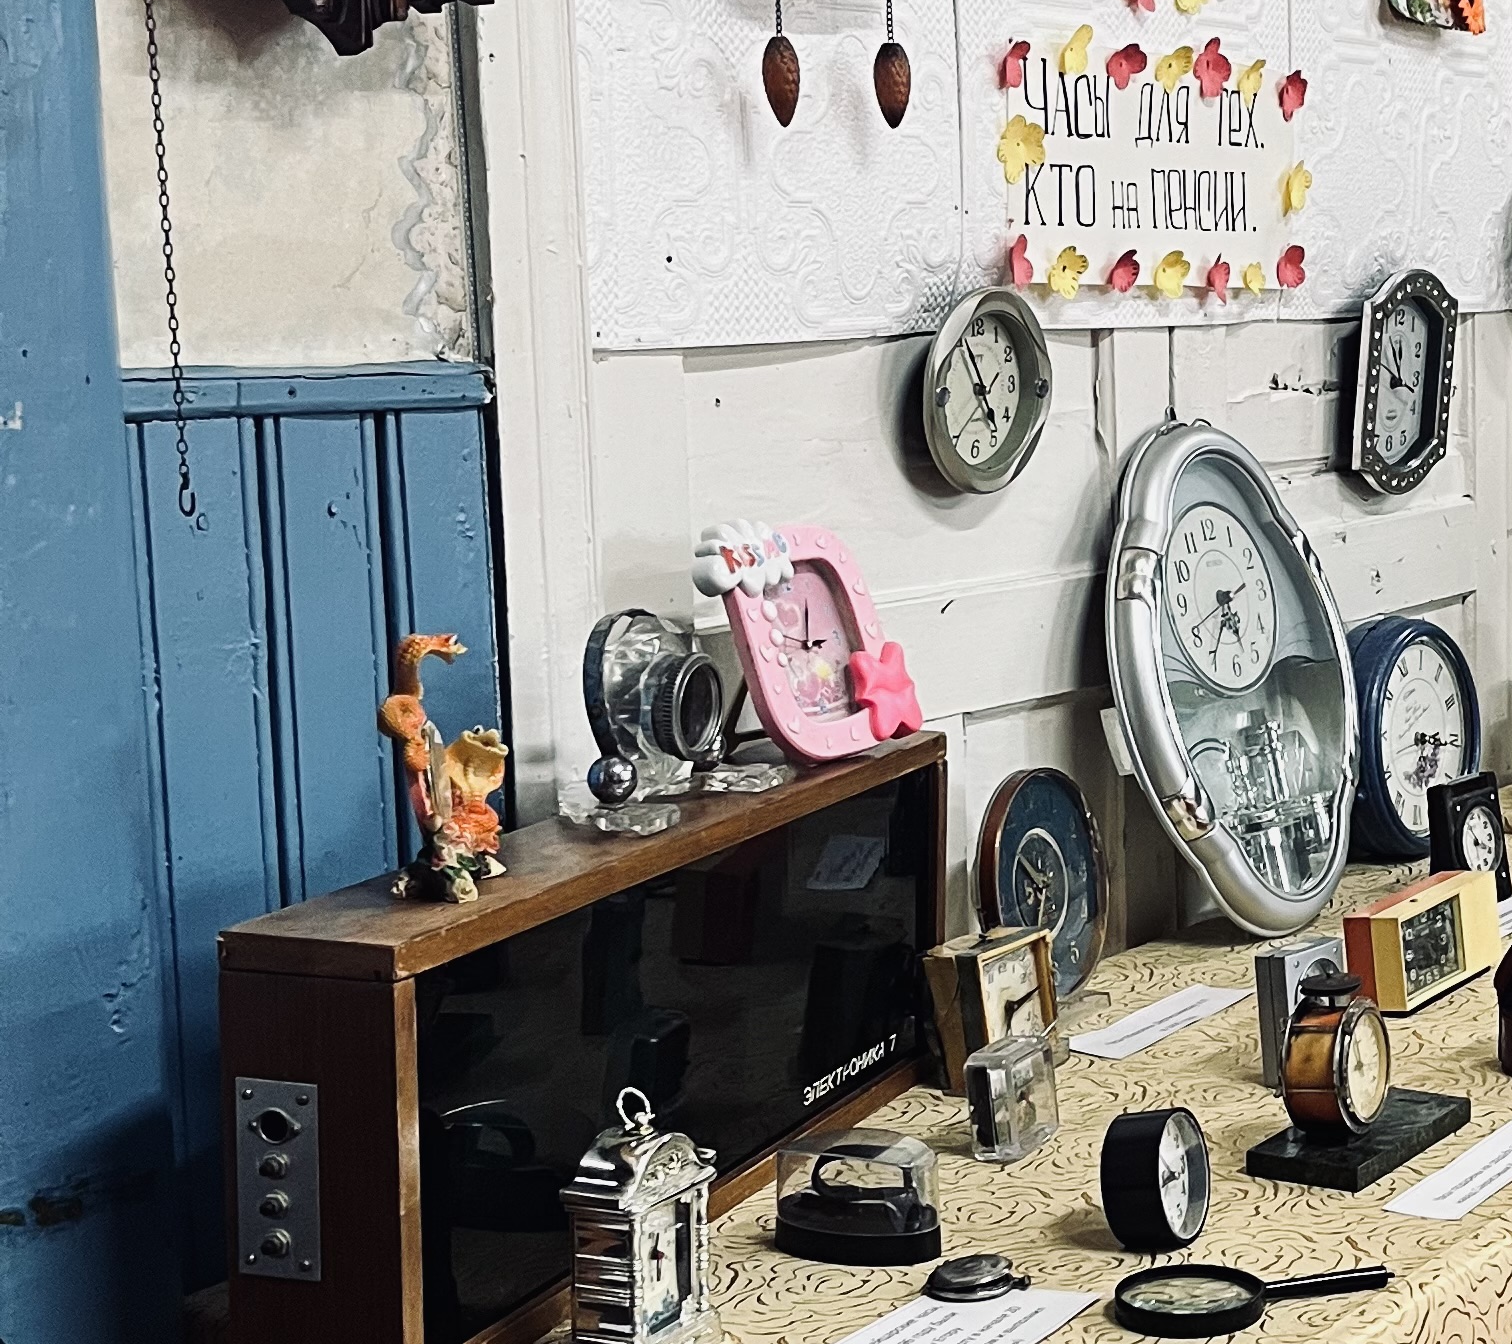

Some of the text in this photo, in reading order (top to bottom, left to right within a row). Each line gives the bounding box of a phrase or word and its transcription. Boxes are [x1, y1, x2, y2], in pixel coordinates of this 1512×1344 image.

[1023, 162, 1096, 227] КТО
[970, 318, 984, 337] 12
[993, 325, 999, 343] 1
[1004, 346, 1012, 363] 2
[1007, 375, 1015, 393] 3
[1001, 406, 1011, 423] 4
[970, 439, 979, 458] 6
[989, 429, 998, 447] 5
[1200, 518, 1216, 541] 12
[1226, 525, 1233, 547] 1
[1184, 532, 1198, 554] 11
[1243, 547, 1254, 570] 2
[1174, 559, 1190, 583] 10
[1256, 579, 1267, 601] 3
[1177, 593, 1187, 617] 9
[1256, 612, 1265, 634] 4
[1191, 625, 1202, 648] 8
[1250, 641, 1260, 664] 5
[1232, 654, 1242, 677] 6
[889, 1033, 897, 1051] 7
